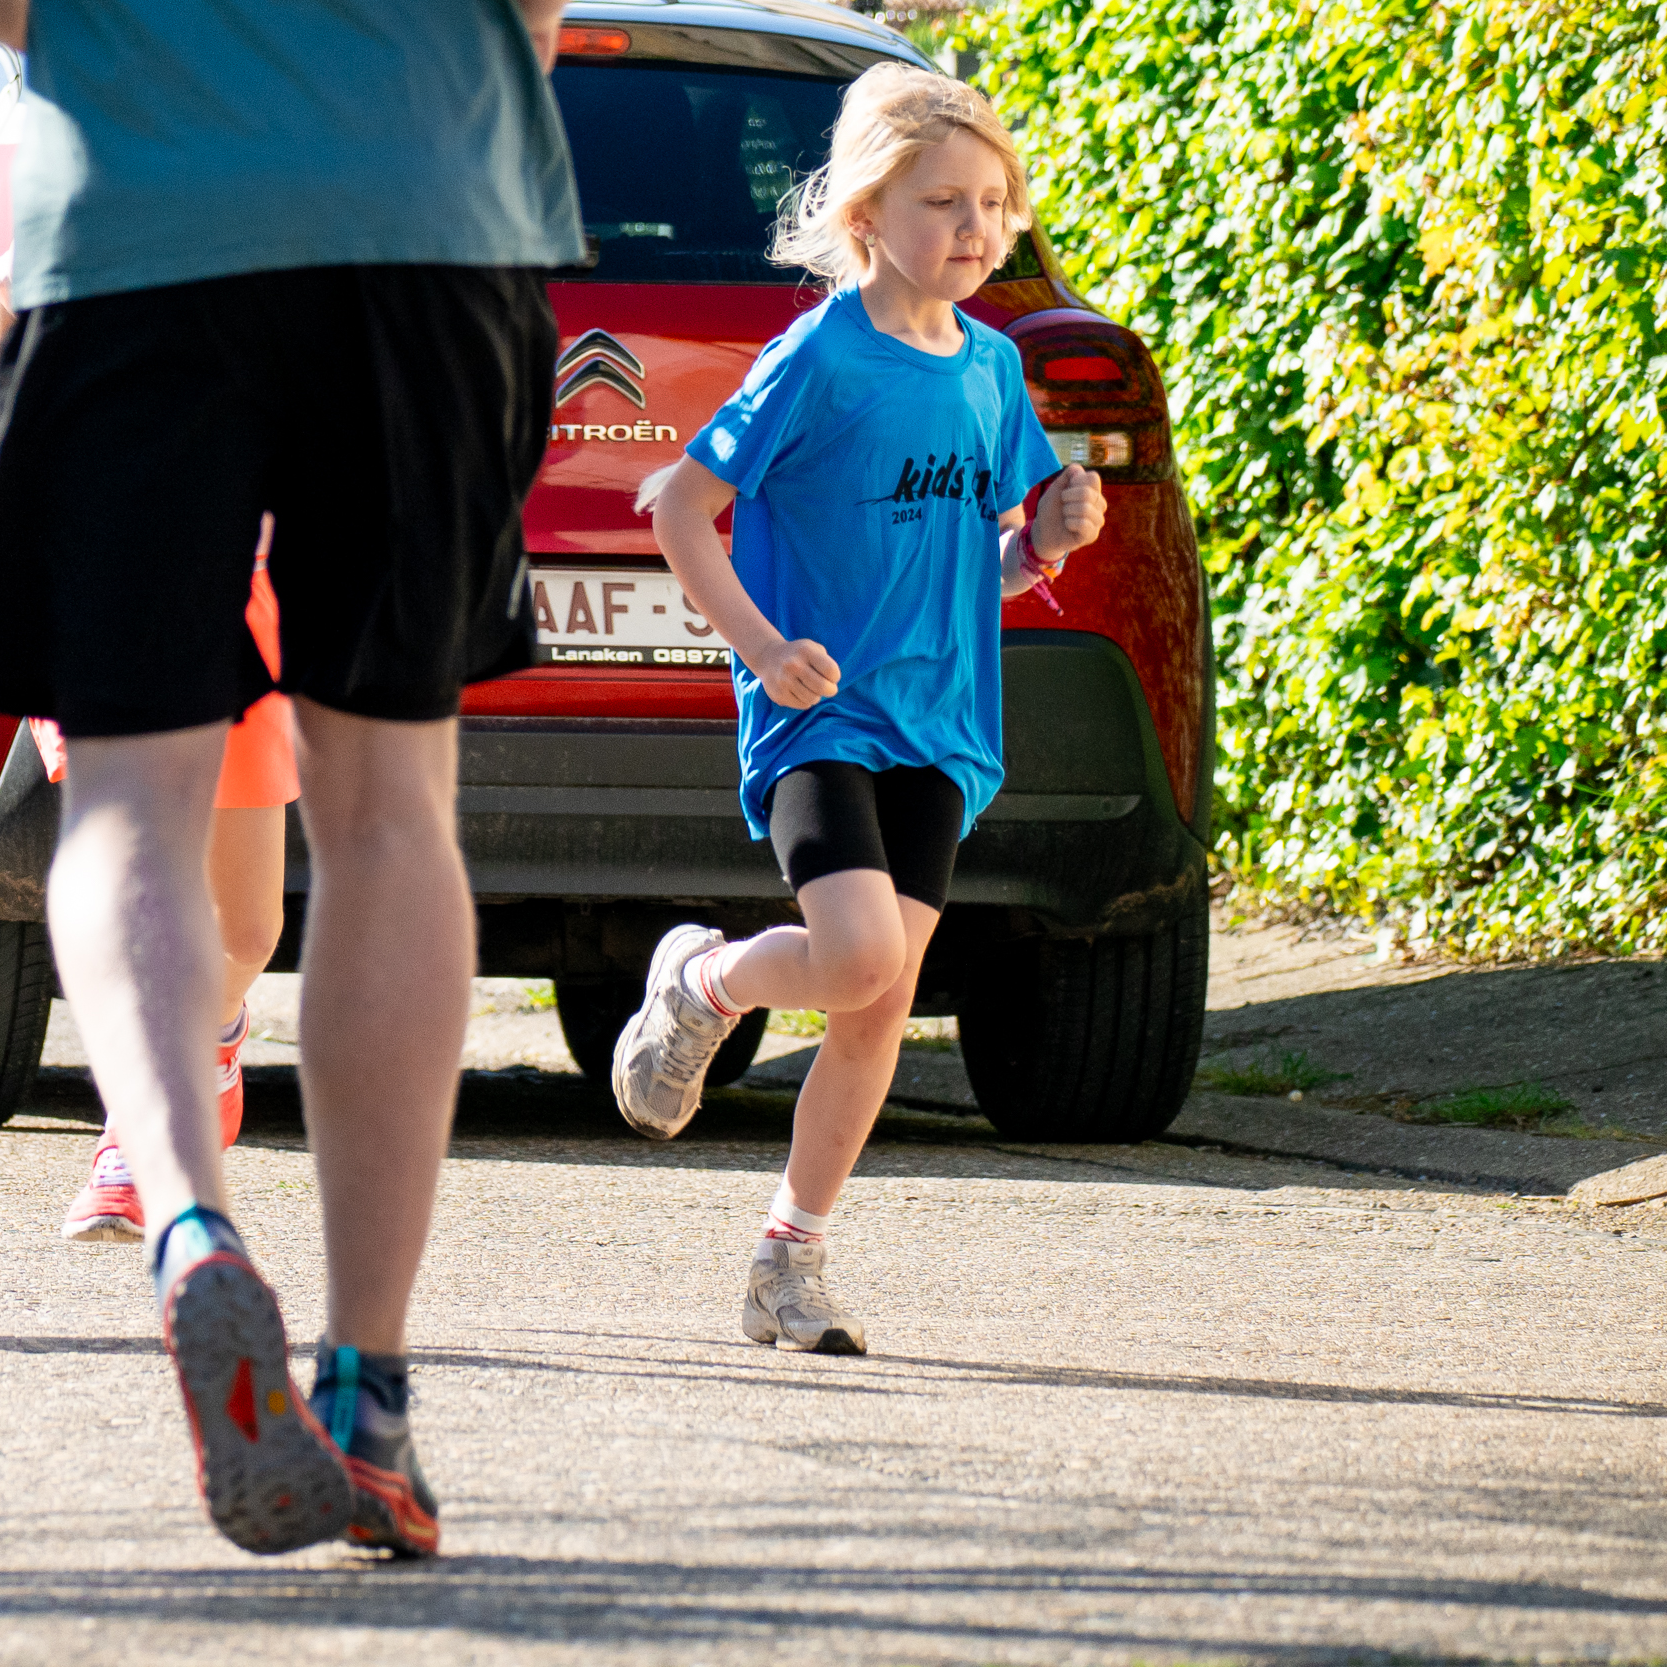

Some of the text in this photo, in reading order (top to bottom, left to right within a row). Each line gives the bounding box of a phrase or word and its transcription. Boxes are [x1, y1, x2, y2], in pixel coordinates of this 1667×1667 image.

[548, 419, 679, 442] ITROËN
[891, 507, 923, 525] 2024
[551, 648, 643, 663] Lanaken
